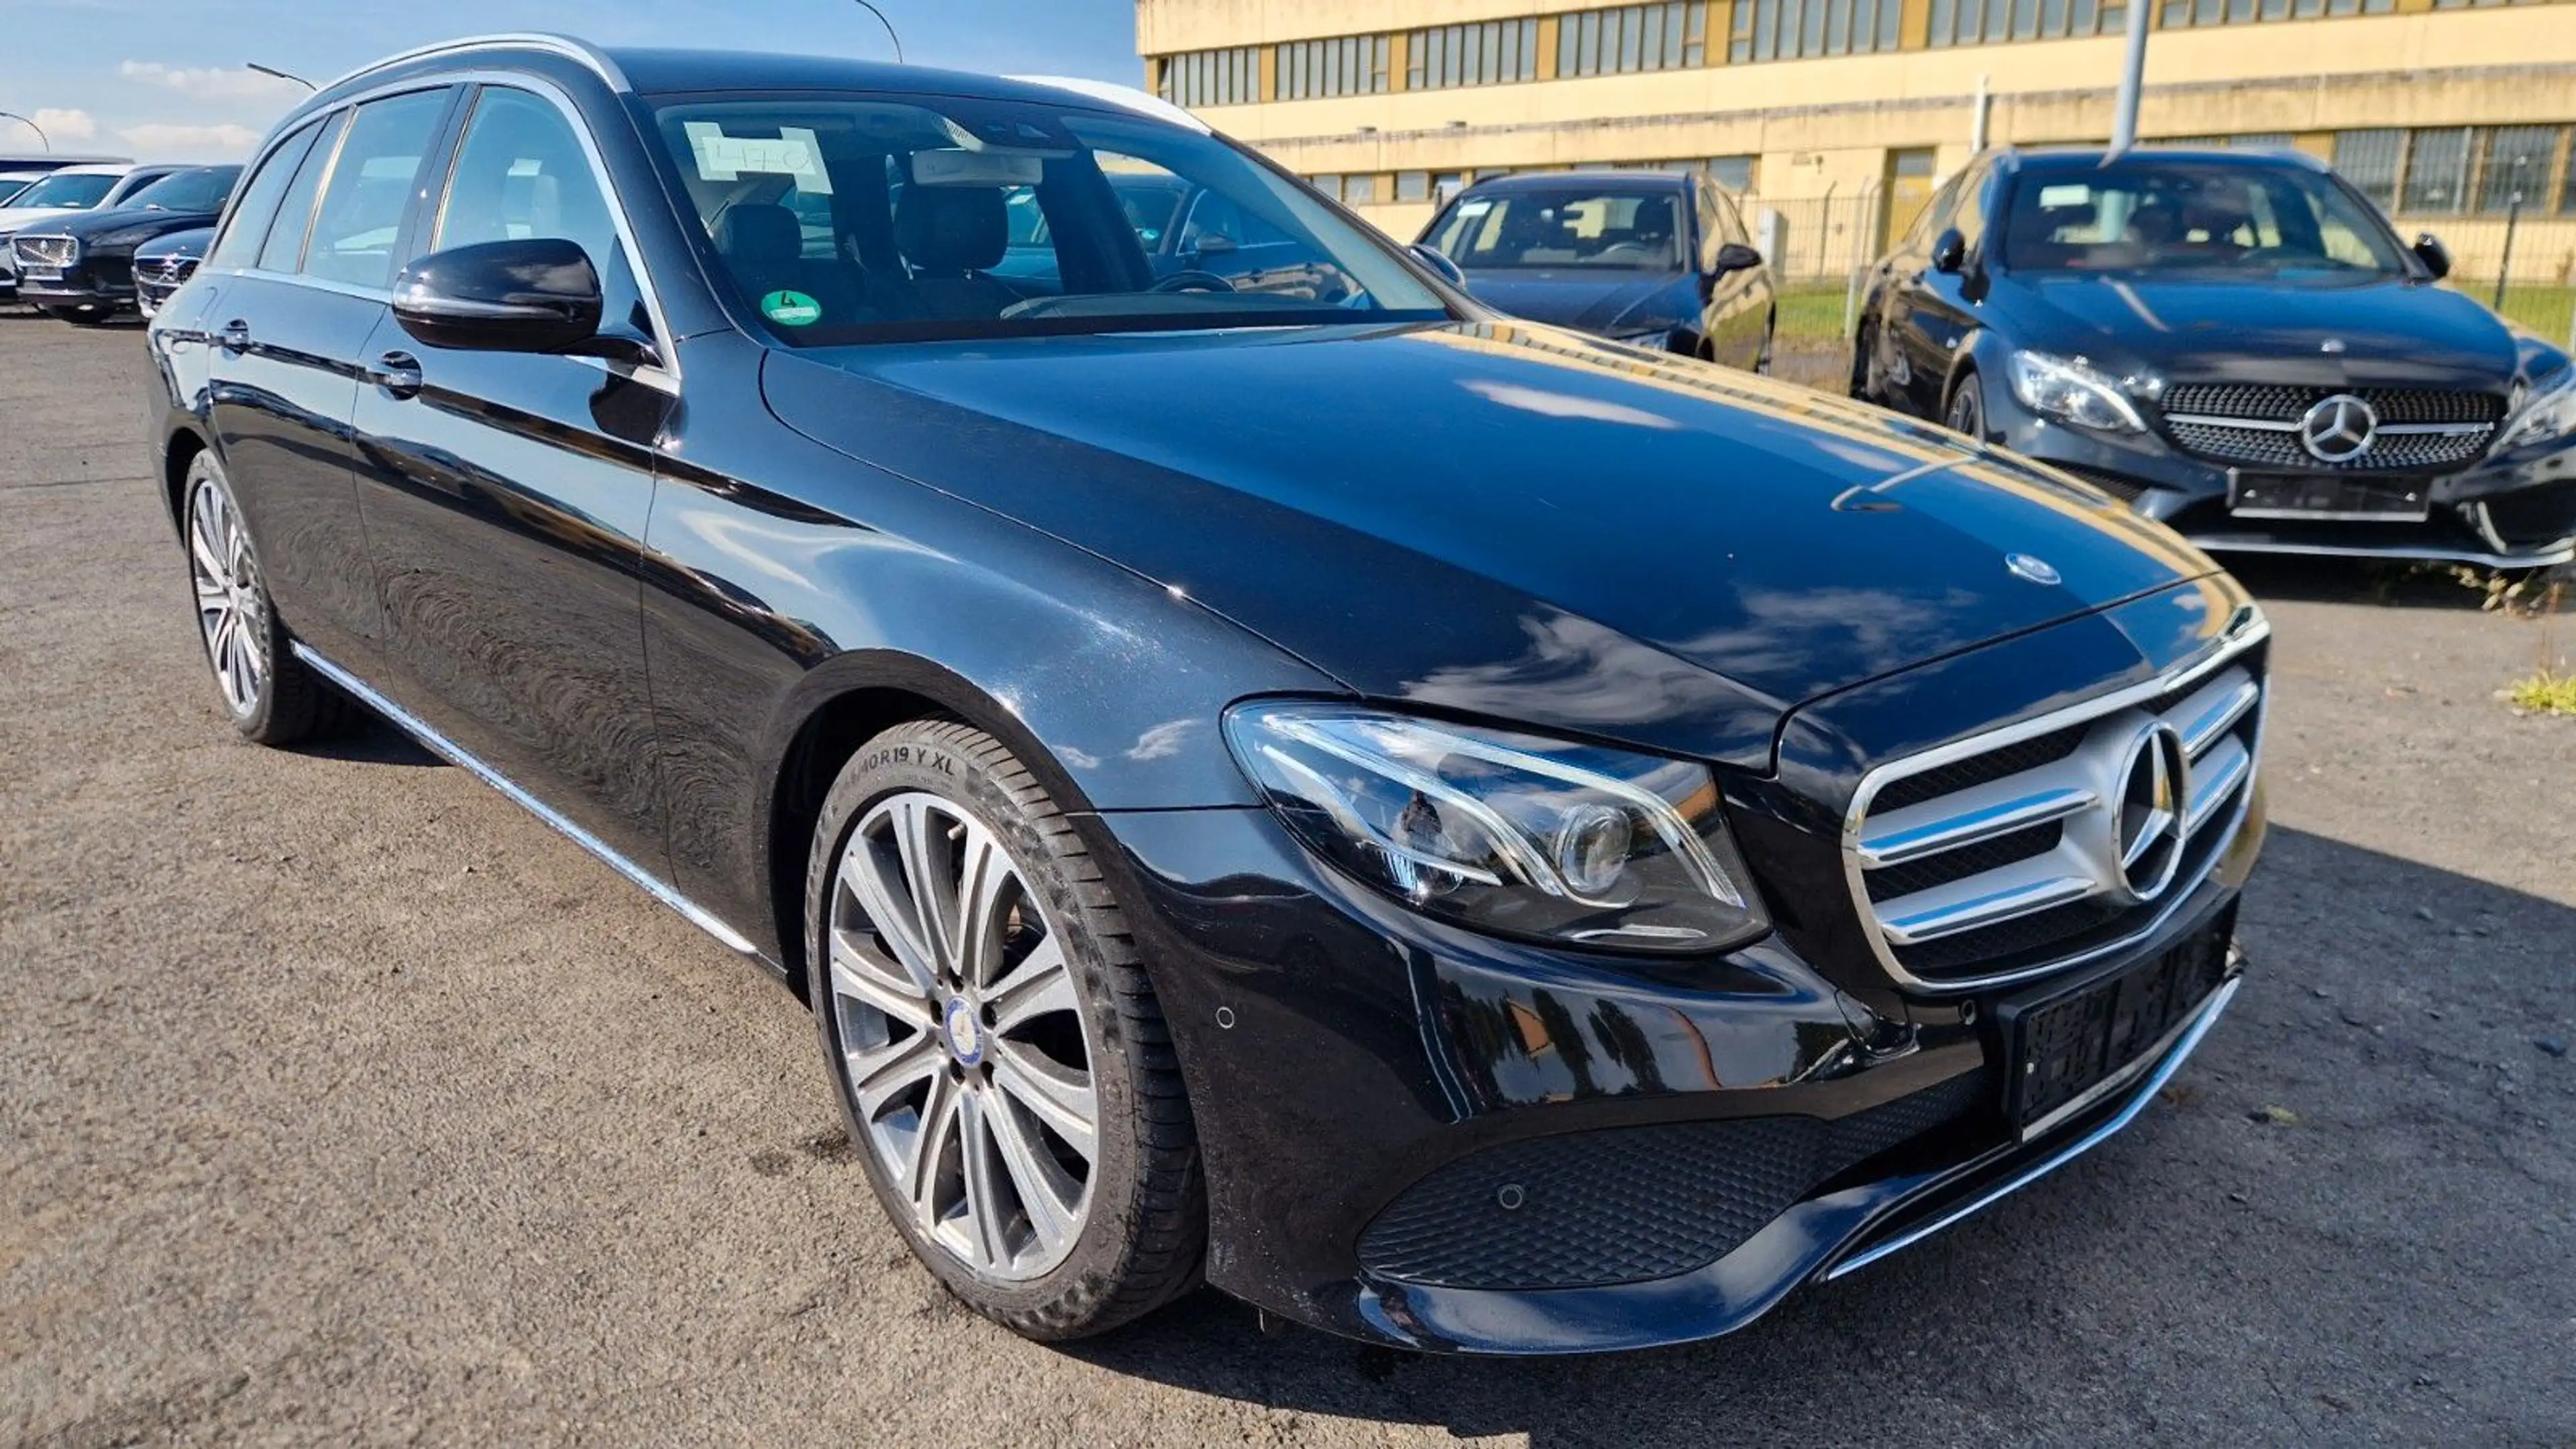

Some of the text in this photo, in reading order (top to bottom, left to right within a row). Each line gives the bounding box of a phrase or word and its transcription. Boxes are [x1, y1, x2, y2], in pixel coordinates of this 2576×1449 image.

[781, 291, 798, 308] 4
[916, 747, 926, 765] Y
[931, 752, 955, 776] XL
